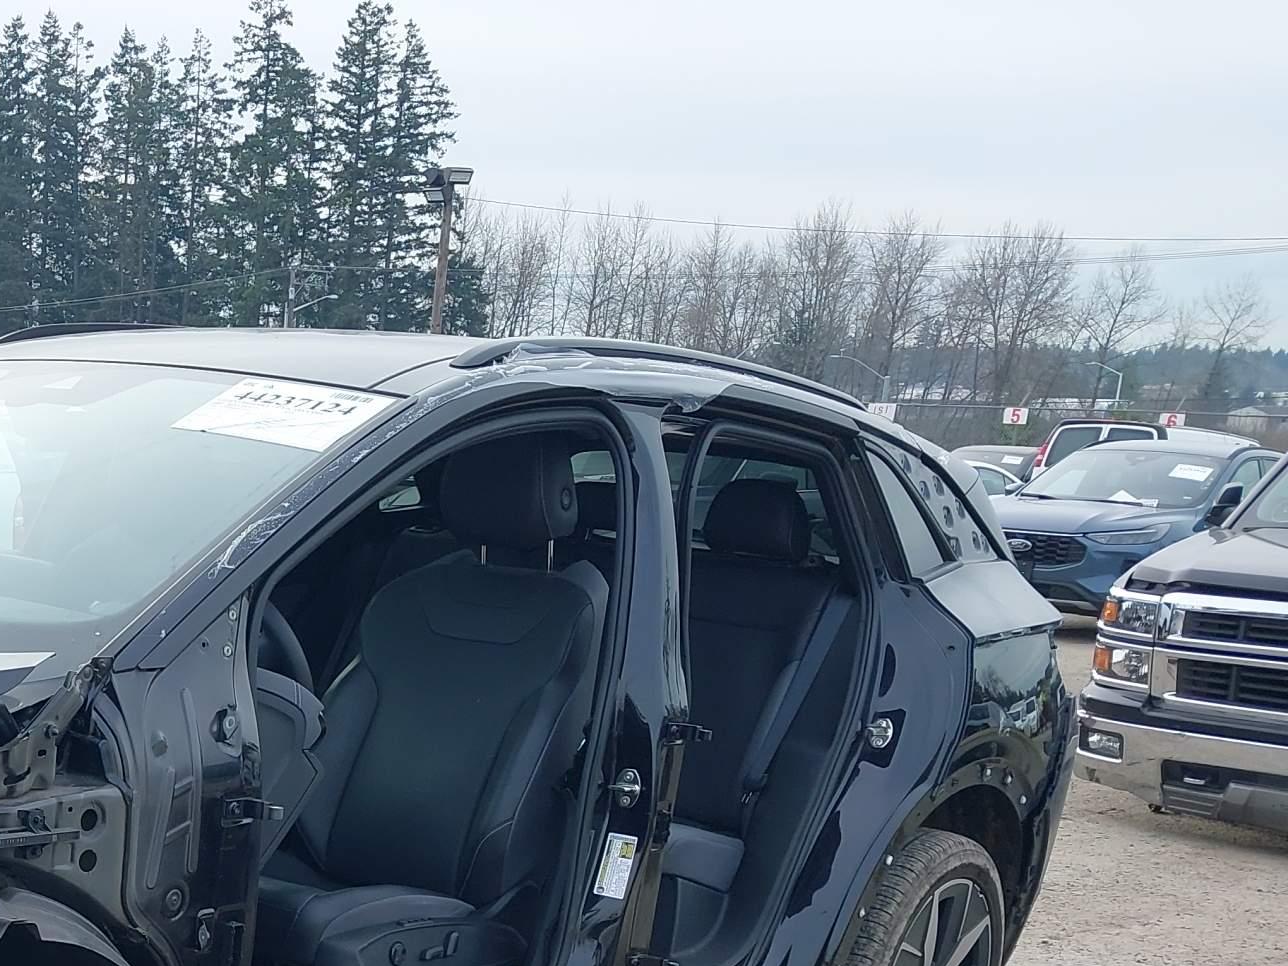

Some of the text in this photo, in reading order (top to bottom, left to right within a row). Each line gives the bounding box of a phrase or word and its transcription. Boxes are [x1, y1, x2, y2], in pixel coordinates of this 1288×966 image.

[233, 390, 358, 416] 44237124
[1010, 408, 1022, 424] 5
[1166, 414, 1178, 428] 6
